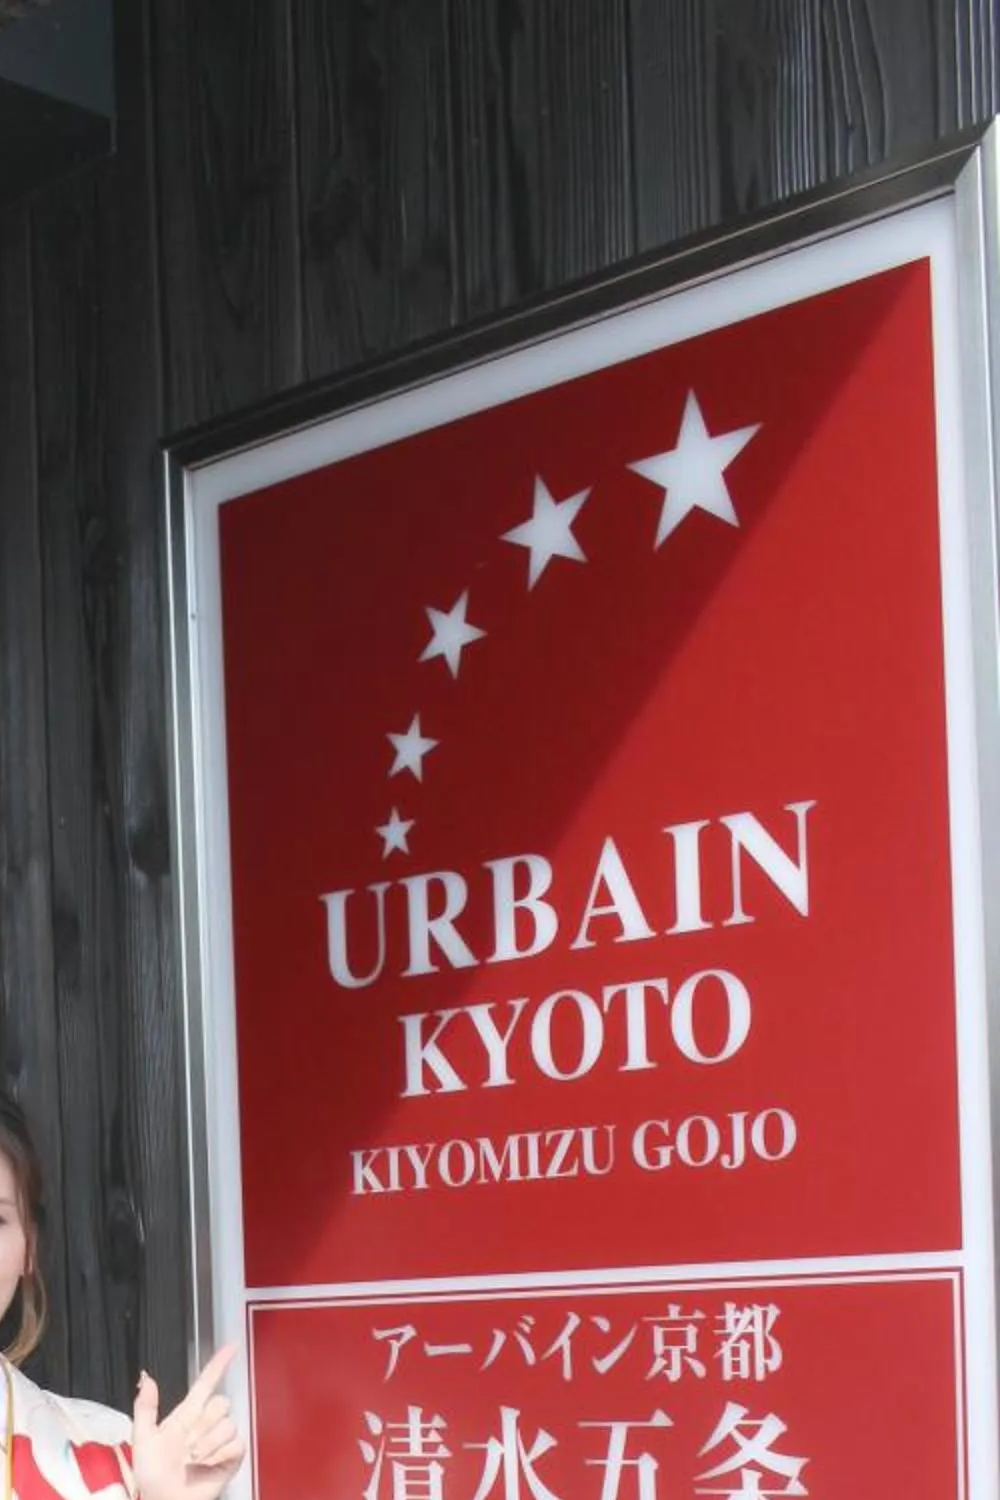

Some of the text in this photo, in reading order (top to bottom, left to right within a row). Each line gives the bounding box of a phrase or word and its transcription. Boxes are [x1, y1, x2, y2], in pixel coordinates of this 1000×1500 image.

[321, 799, 817, 990] URBAIN
[400, 968, 753, 1098] KYOTO
[351, 1107, 799, 1196] KIYOMIZU GOJO
[372, 1301, 785, 1384] アーバイン京都
